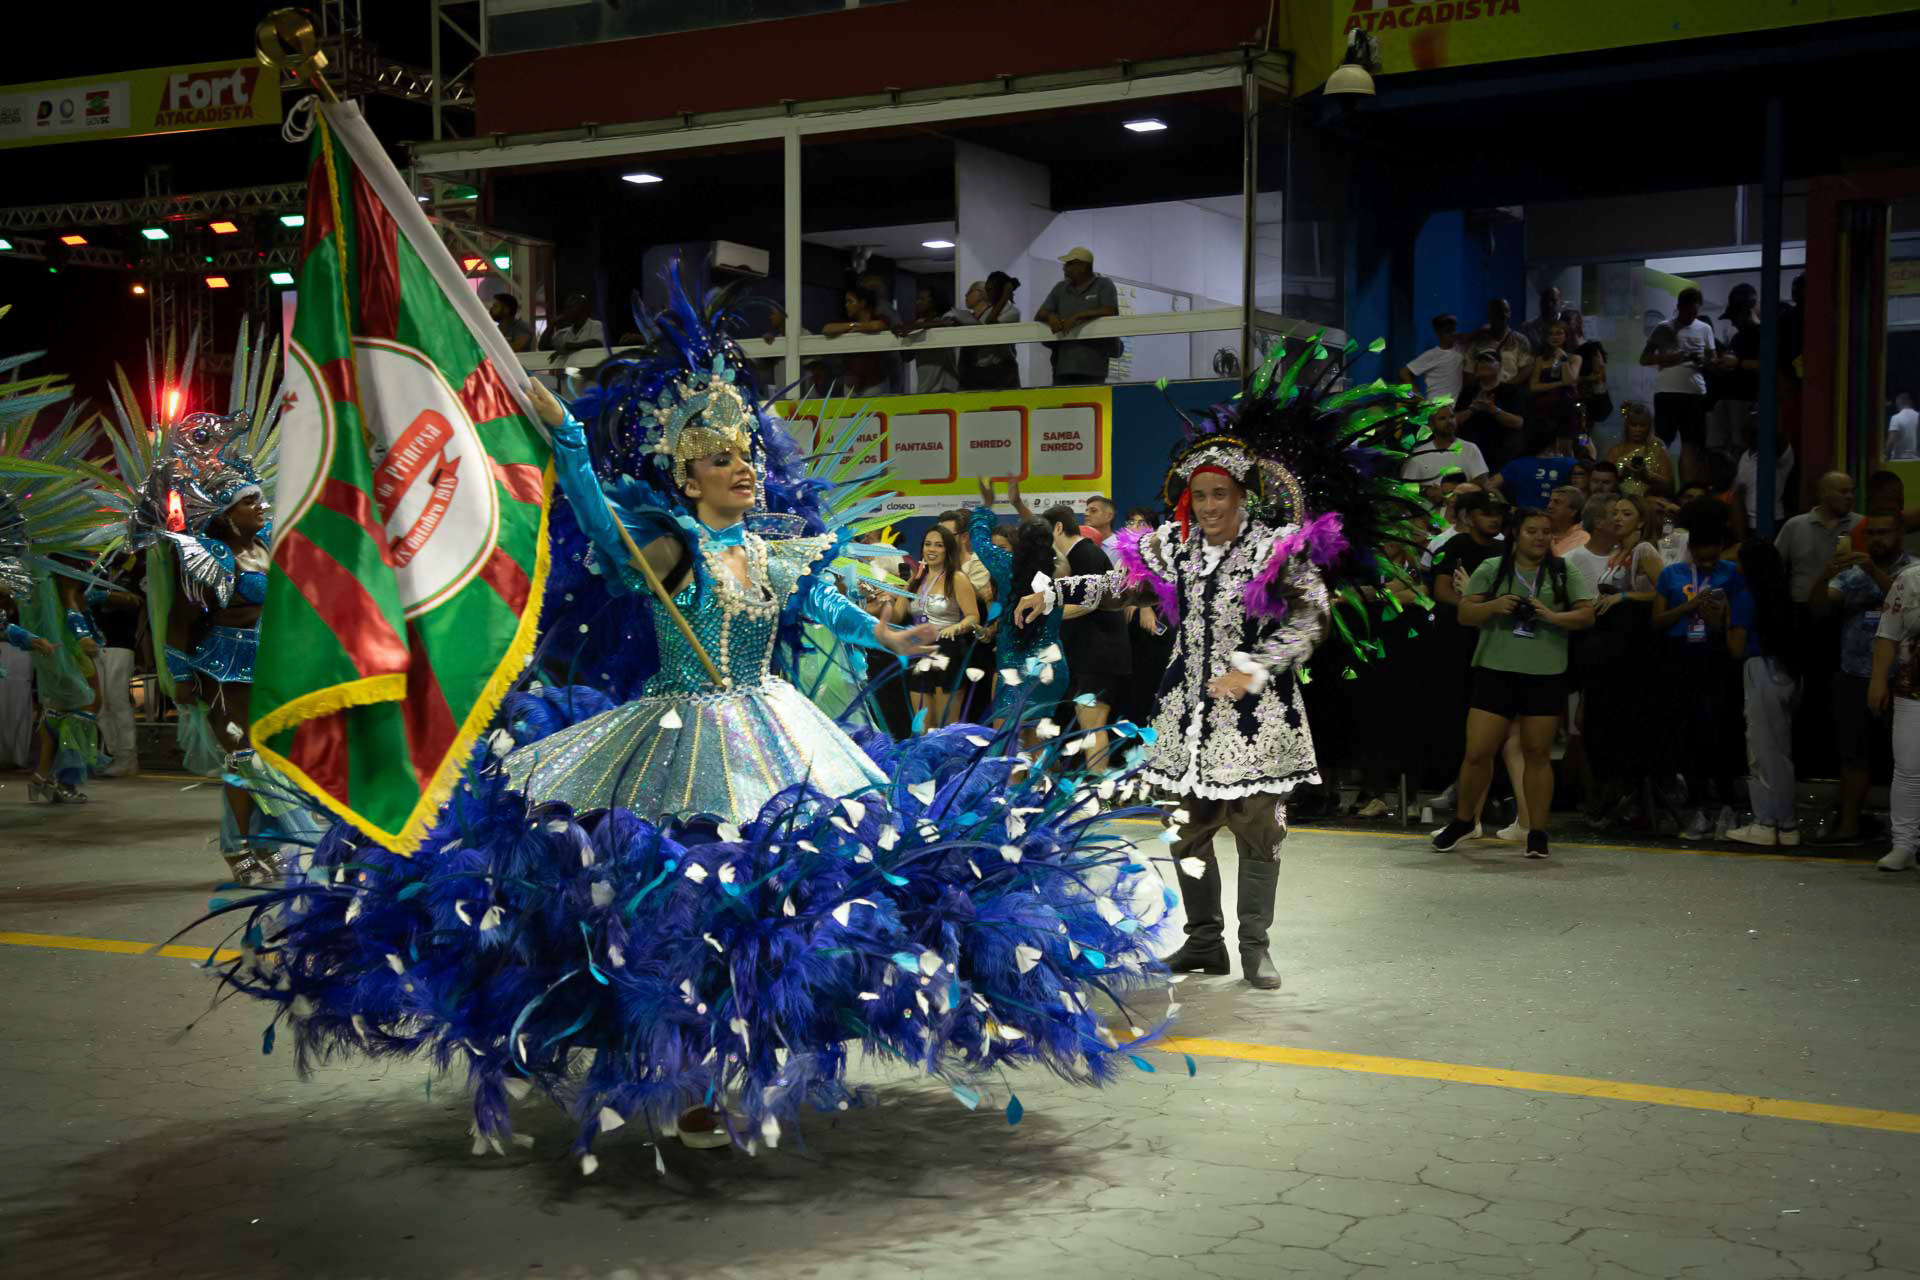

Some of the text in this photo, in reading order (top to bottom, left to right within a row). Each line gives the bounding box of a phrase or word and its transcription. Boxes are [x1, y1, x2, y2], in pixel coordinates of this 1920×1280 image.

[1343, 0, 1520, 35] ATACADISTA
[169, 67, 250, 111] Fort
[154, 104, 254, 127] ATACADISTA
[969, 438, 1012, 449] ENREDO
[1043, 430, 1081, 441] SAMBA
[385, 423, 443, 481] Princesa
[895, 441, 944, 452] FANTASIA
[1040, 441, 1083, 452] ENREDO
